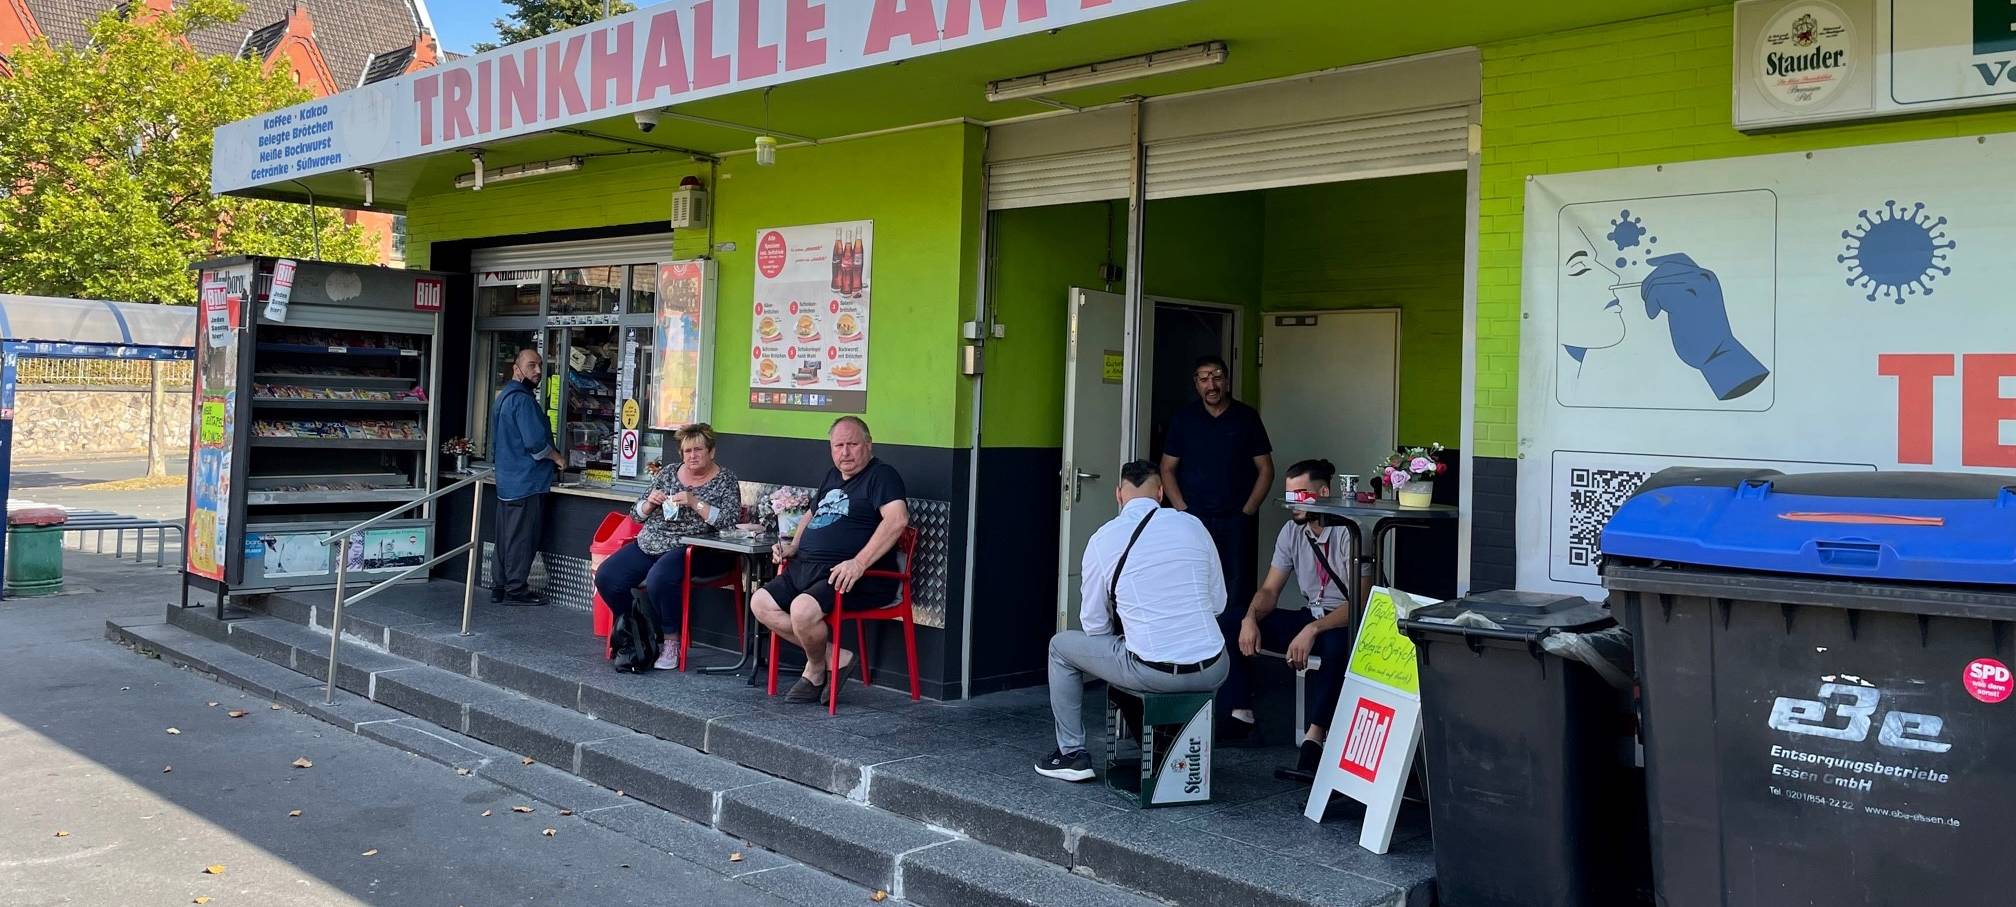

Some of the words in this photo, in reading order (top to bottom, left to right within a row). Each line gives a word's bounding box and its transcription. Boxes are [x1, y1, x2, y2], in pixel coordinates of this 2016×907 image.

[413, 0, 827, 147] TRINKHALLE
[264, 114, 292, 130] Kaffee
[300, 105, 328, 121] Kakao
[259, 130, 290, 147] Belegte
[293, 120, 334, 140] Brötchen
[260, 148, 282, 163] Heiße
[285, 137, 332, 157] Bockwurst
[251, 163, 289, 180] Getränke
[296, 153, 342, 172] Süßwaren
[206, 287, 227, 304] Bild
[416, 282, 441, 306] Bild
[1970, 662, 2010, 682] SPD
[1987, 683, 2006, 691] denn
[1344, 706, 1389, 771] Bild
[1770, 745, 1949, 784] Entsorgungsbetriebe
[1771, 764, 1818, 782] Essen
[1822, 773, 1873, 793] GmbH
